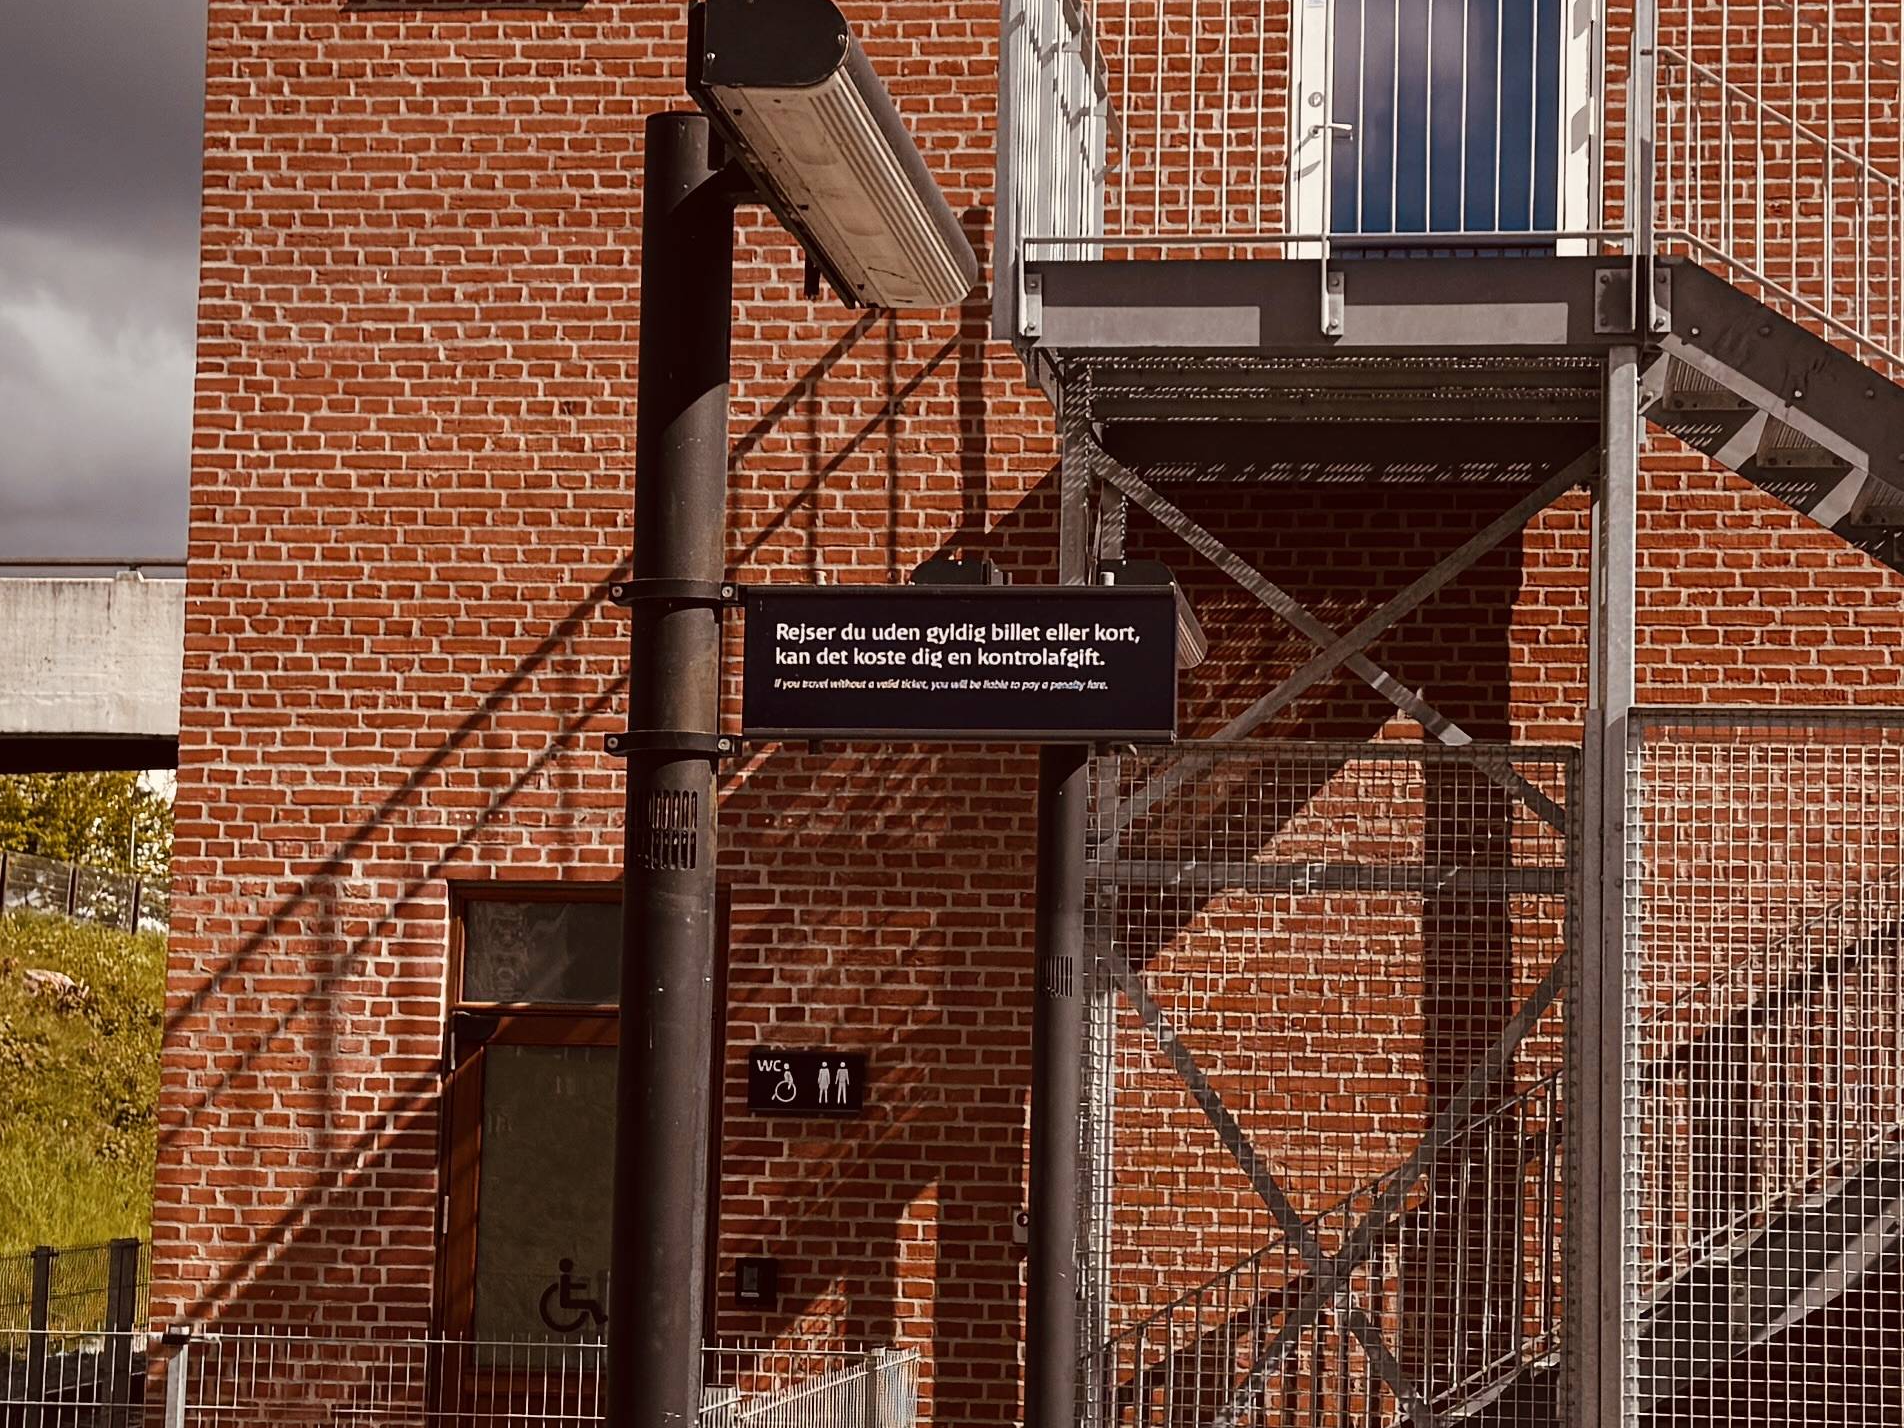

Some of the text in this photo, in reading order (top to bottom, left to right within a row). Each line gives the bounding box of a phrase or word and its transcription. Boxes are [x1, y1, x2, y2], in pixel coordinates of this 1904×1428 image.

[777, 623, 1140, 644] Rejser du uden gyldig billet eller kort,
[776, 647, 1105, 668] kan det koste dig en kontrolafgift.
[782, 681, 800, 690] you
[830, 679, 866, 689] without
[931, 681, 949, 691] you
[969, 679, 981, 689] be
[1010, 680, 1020, 689] to
[1022, 681, 1040, 691] pay
[1042, 681, 1048, 689] a
[757, 1060, 782, 1072] WC
